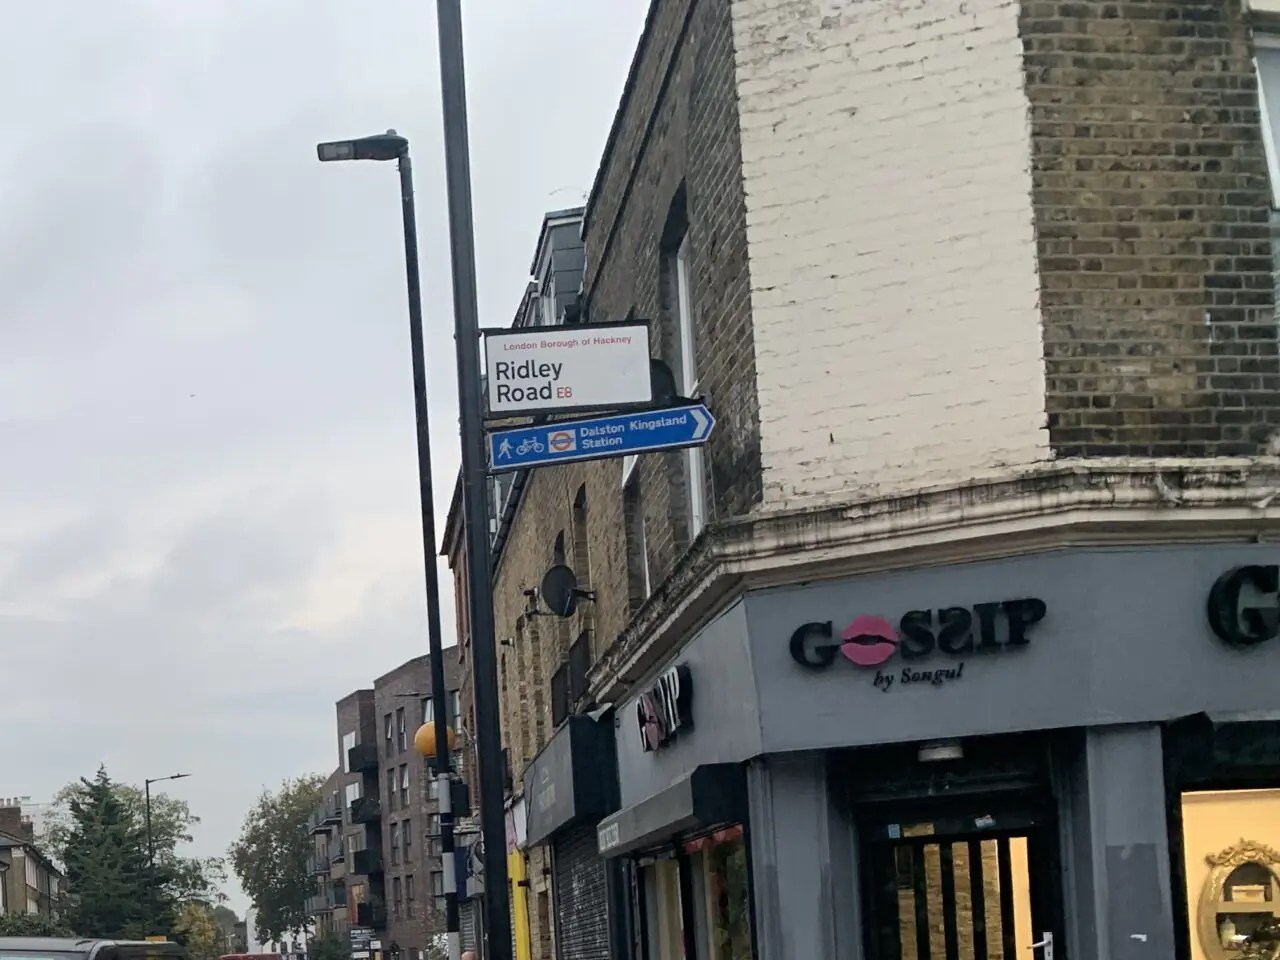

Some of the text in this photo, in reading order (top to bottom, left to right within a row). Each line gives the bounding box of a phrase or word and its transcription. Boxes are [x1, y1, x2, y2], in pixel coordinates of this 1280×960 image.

[503, 336, 632, 351] London Borough of Hackney
[495, 359, 562, 381] Ridley
[497, 381, 573, 403] Road E8
[580, 414, 687, 438] Dalston Kingsland
[581, 436, 623, 450] Station
[873, 670, 895, 692] by
